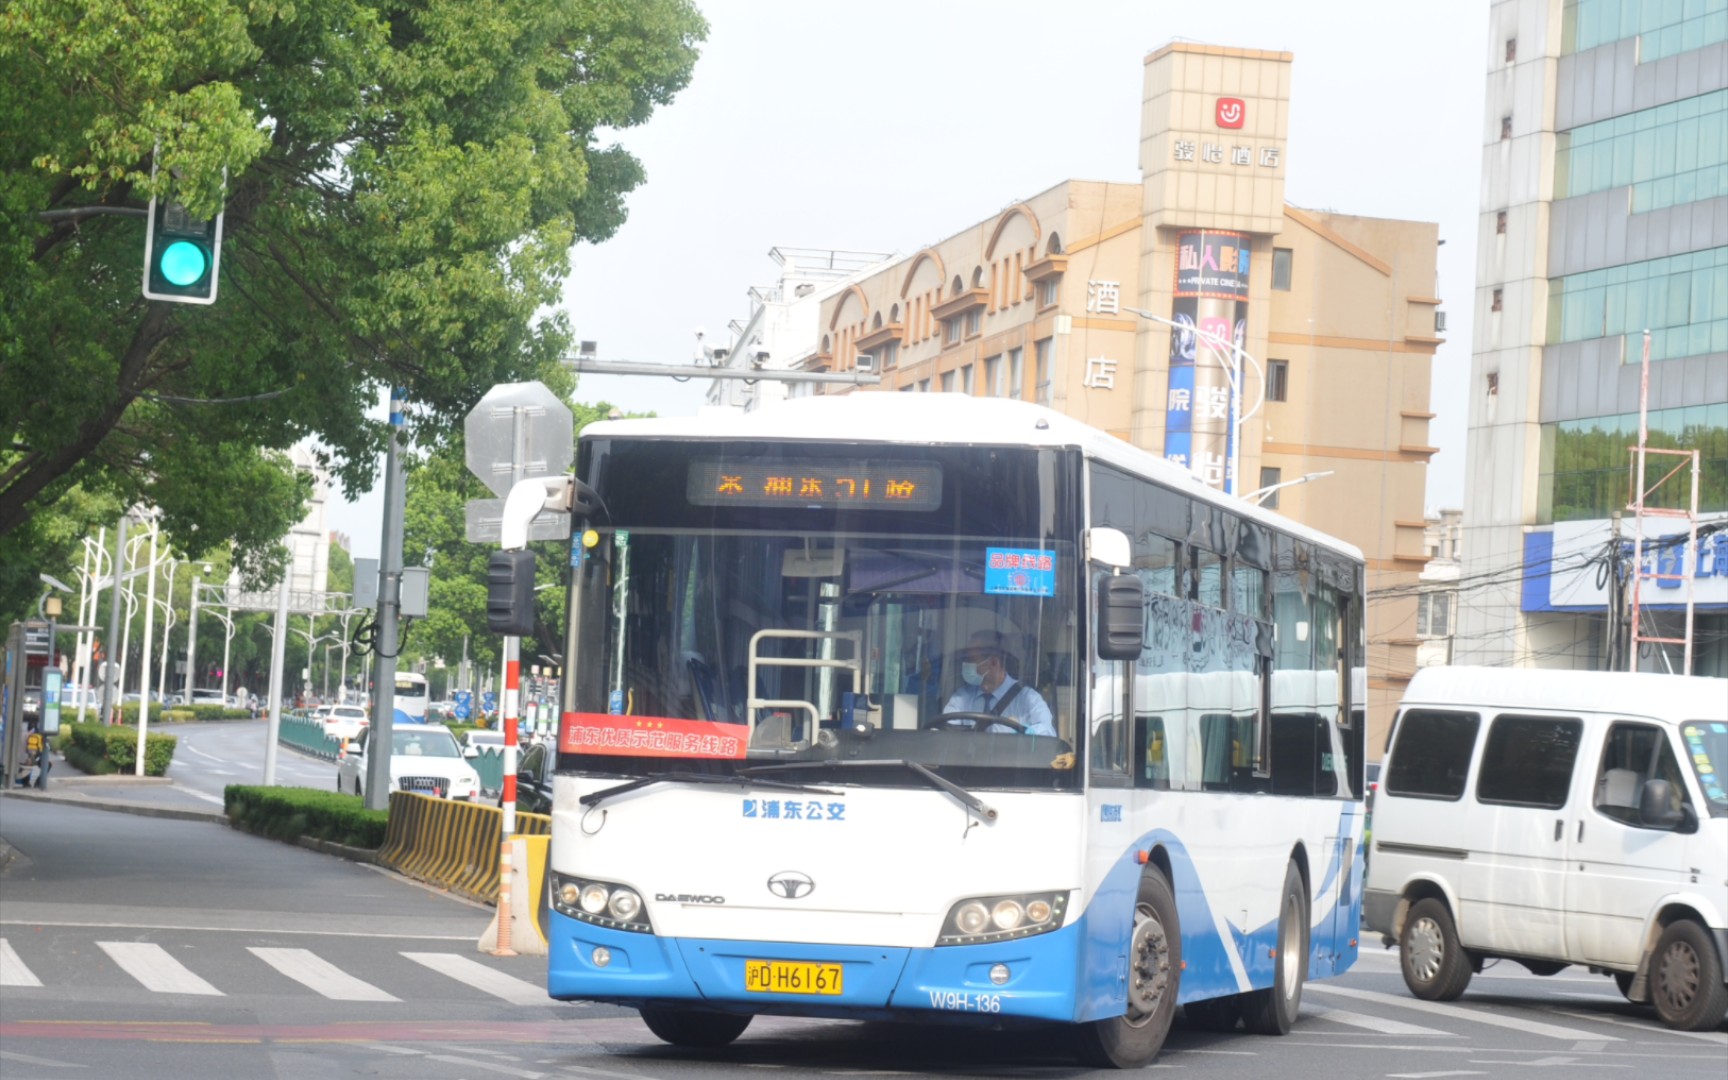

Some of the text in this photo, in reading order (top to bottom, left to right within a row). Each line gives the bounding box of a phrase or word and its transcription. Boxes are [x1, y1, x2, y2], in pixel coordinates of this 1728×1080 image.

[1174, 140, 1280, 168] 骏怡酒店
[1190, 276, 1219, 286] PRVATE
[1083, 279, 1120, 391] 酒店
[568, 725, 739, 757] 浦东优质示范服务线路
[761, 800, 846, 821] 浦东公交
[655, 893, 726, 904] DAEWOO
[929, 991, 1001, 1014] W9H-136
